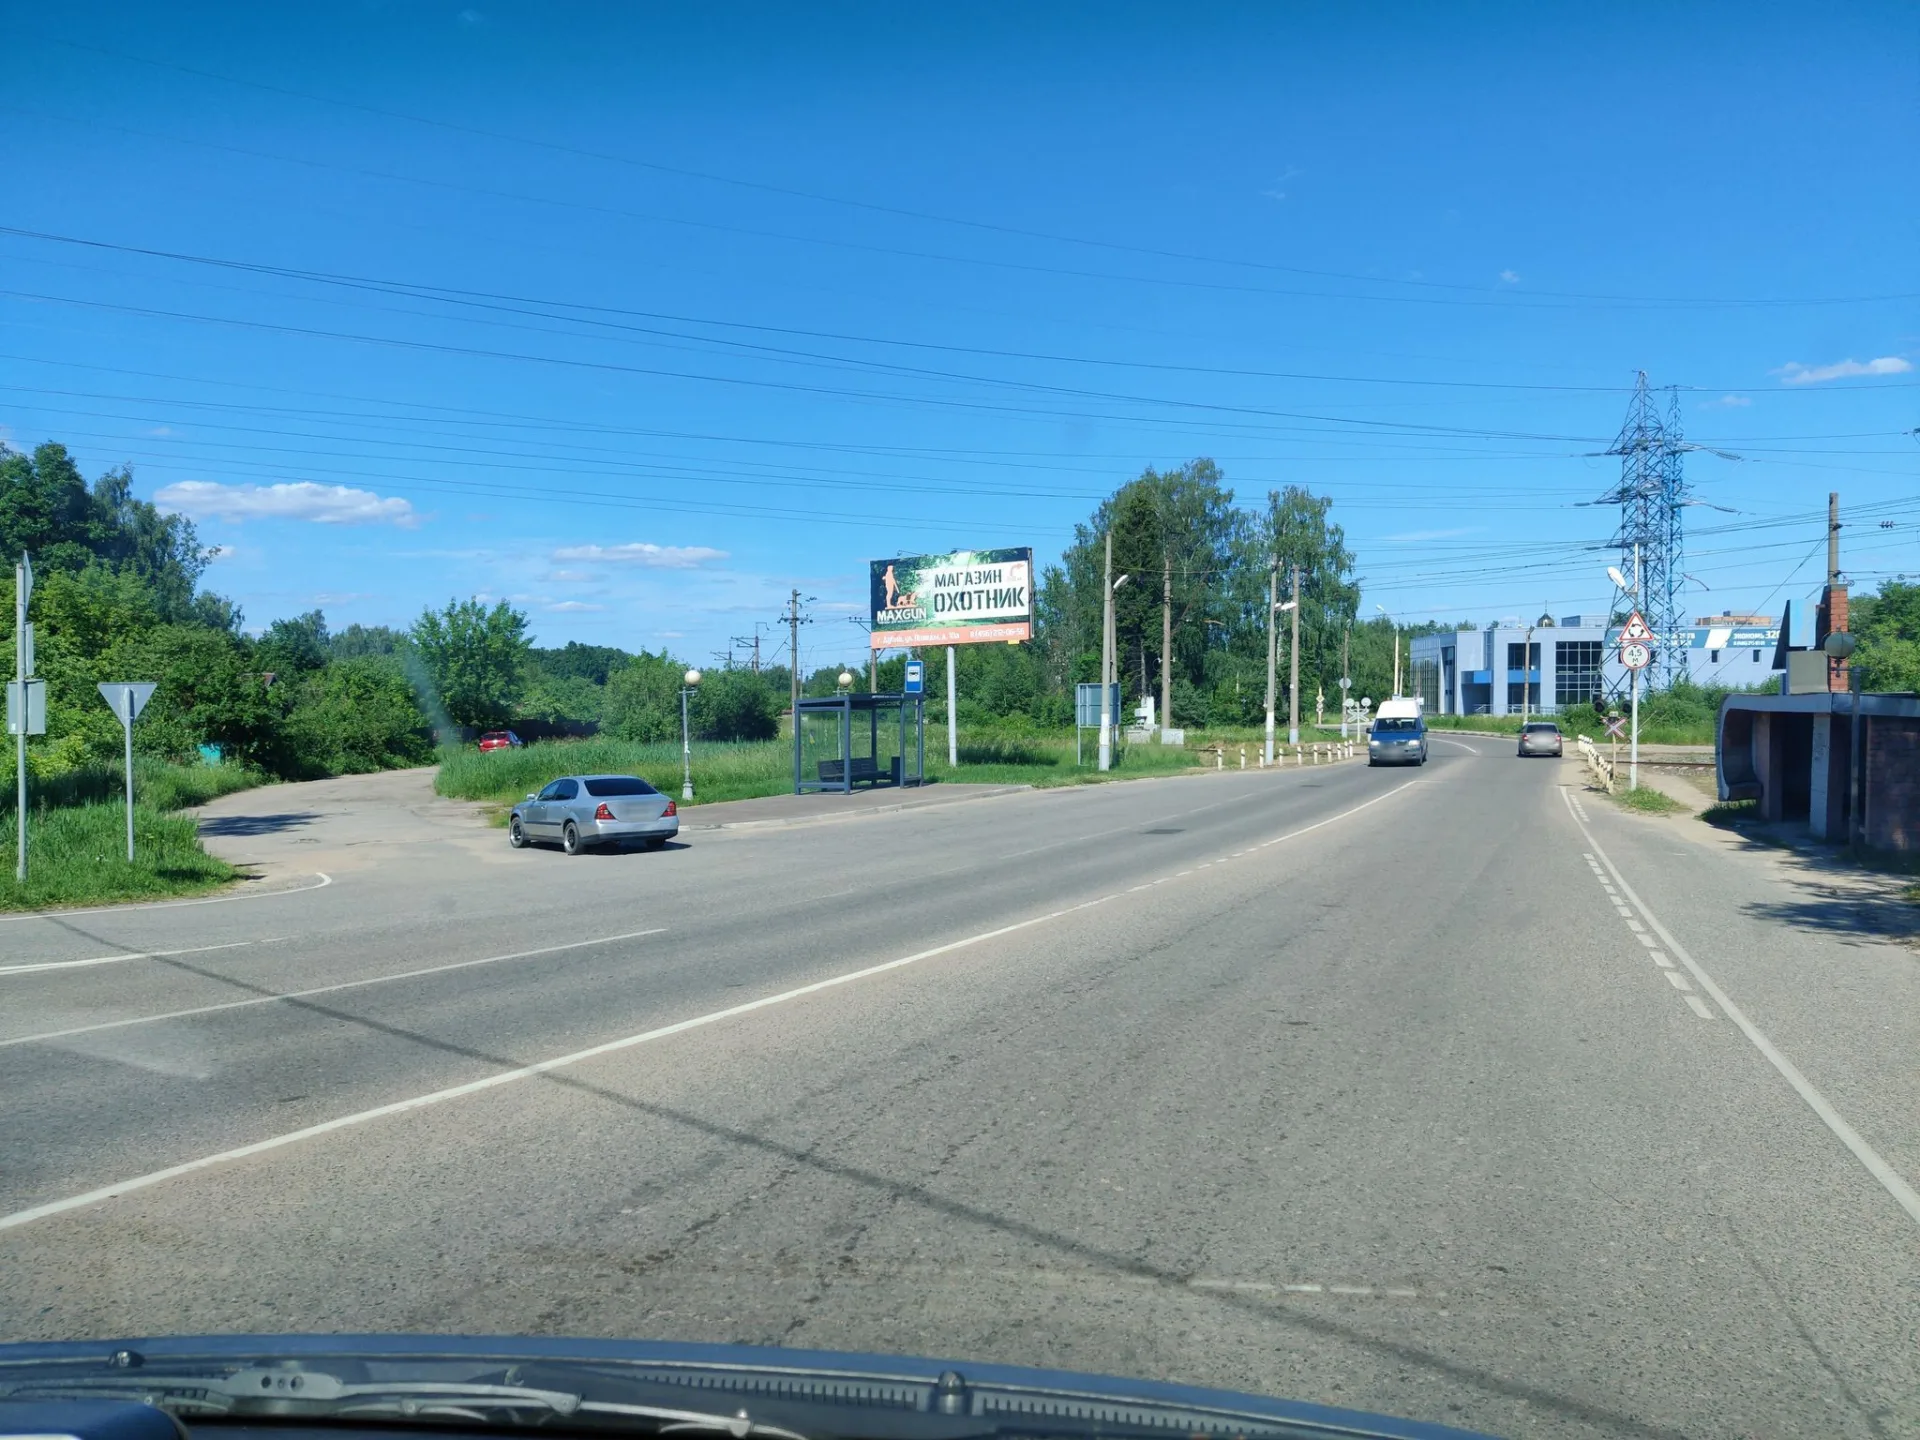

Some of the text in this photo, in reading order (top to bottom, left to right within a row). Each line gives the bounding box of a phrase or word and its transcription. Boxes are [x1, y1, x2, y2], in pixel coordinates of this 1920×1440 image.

[934, 568, 1002, 588] МАГАЗИН
[933, 586, 1025, 613] ОХОТНИК
[876, 607, 926, 622] MAXGUN
[1628, 649, 1642, 657] 4,5
